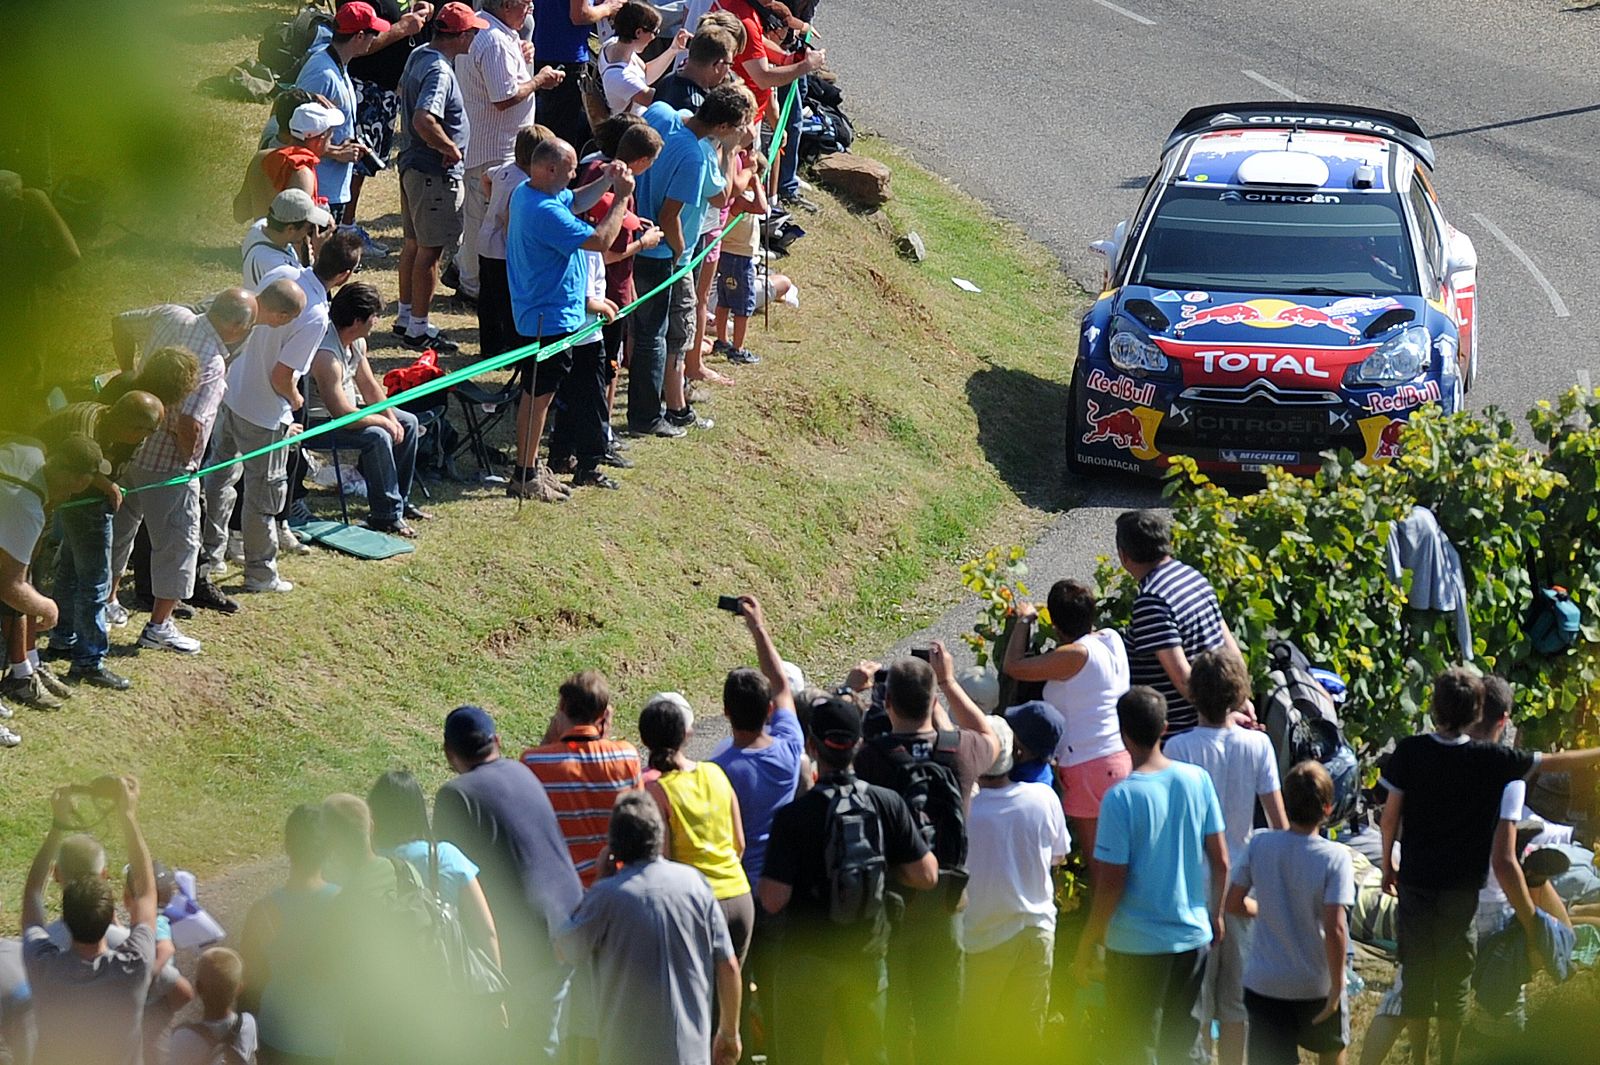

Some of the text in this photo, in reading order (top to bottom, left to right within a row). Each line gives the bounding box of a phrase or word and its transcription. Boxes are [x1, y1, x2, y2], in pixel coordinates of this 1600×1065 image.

[1194, 350, 1328, 377] TOTAL
[1077, 453, 1141, 473] EURODATACAR
[1239, 452, 1296, 461] MICHELIN
